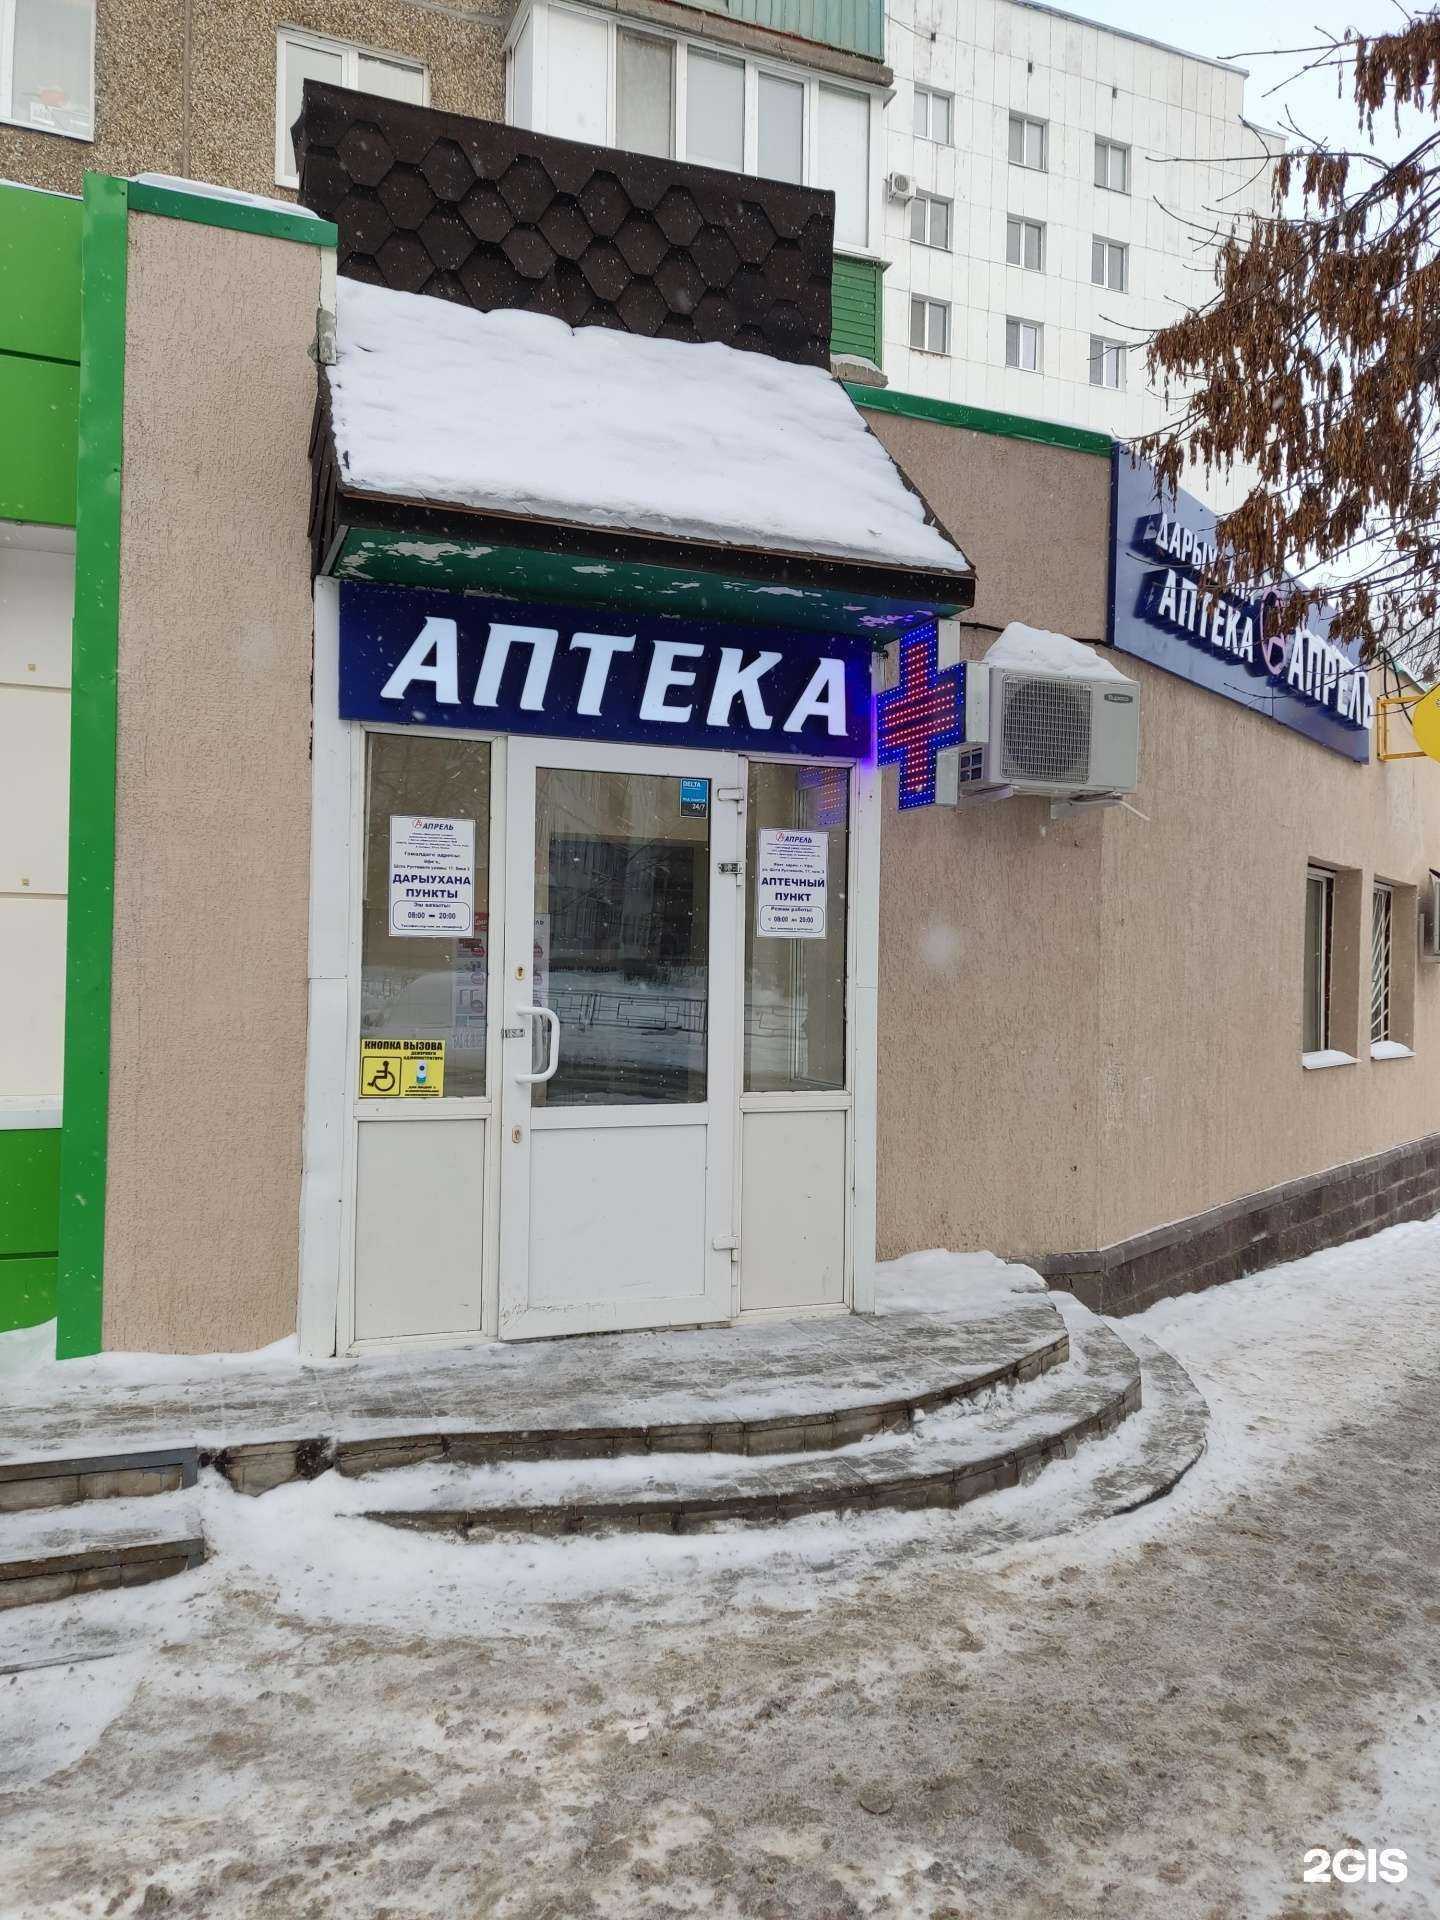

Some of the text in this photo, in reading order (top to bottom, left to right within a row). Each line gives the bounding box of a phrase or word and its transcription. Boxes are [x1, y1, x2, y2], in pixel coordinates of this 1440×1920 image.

[1158, 568, 1254, 663] АПТЕКА
[379, 616, 849, 736] АПТЕКА
[422, 823, 454, 831] АПРЕЛЬ
[784, 835, 813, 843] АПРЕЛЬ
[392, 874, 471, 885] ДАРЫУХАНА
[761, 876, 825, 888] АПТЕЧНЫЙ
[405, 888, 458, 899] ПУНКТЫ
[775, 892, 812, 902] ПУНКТ
[407, 911, 426, 919] 08:00
[438, 912, 456, 920] 20:00
[364, 1041, 443, 1051] КНОПКА ВЫЗОВА
